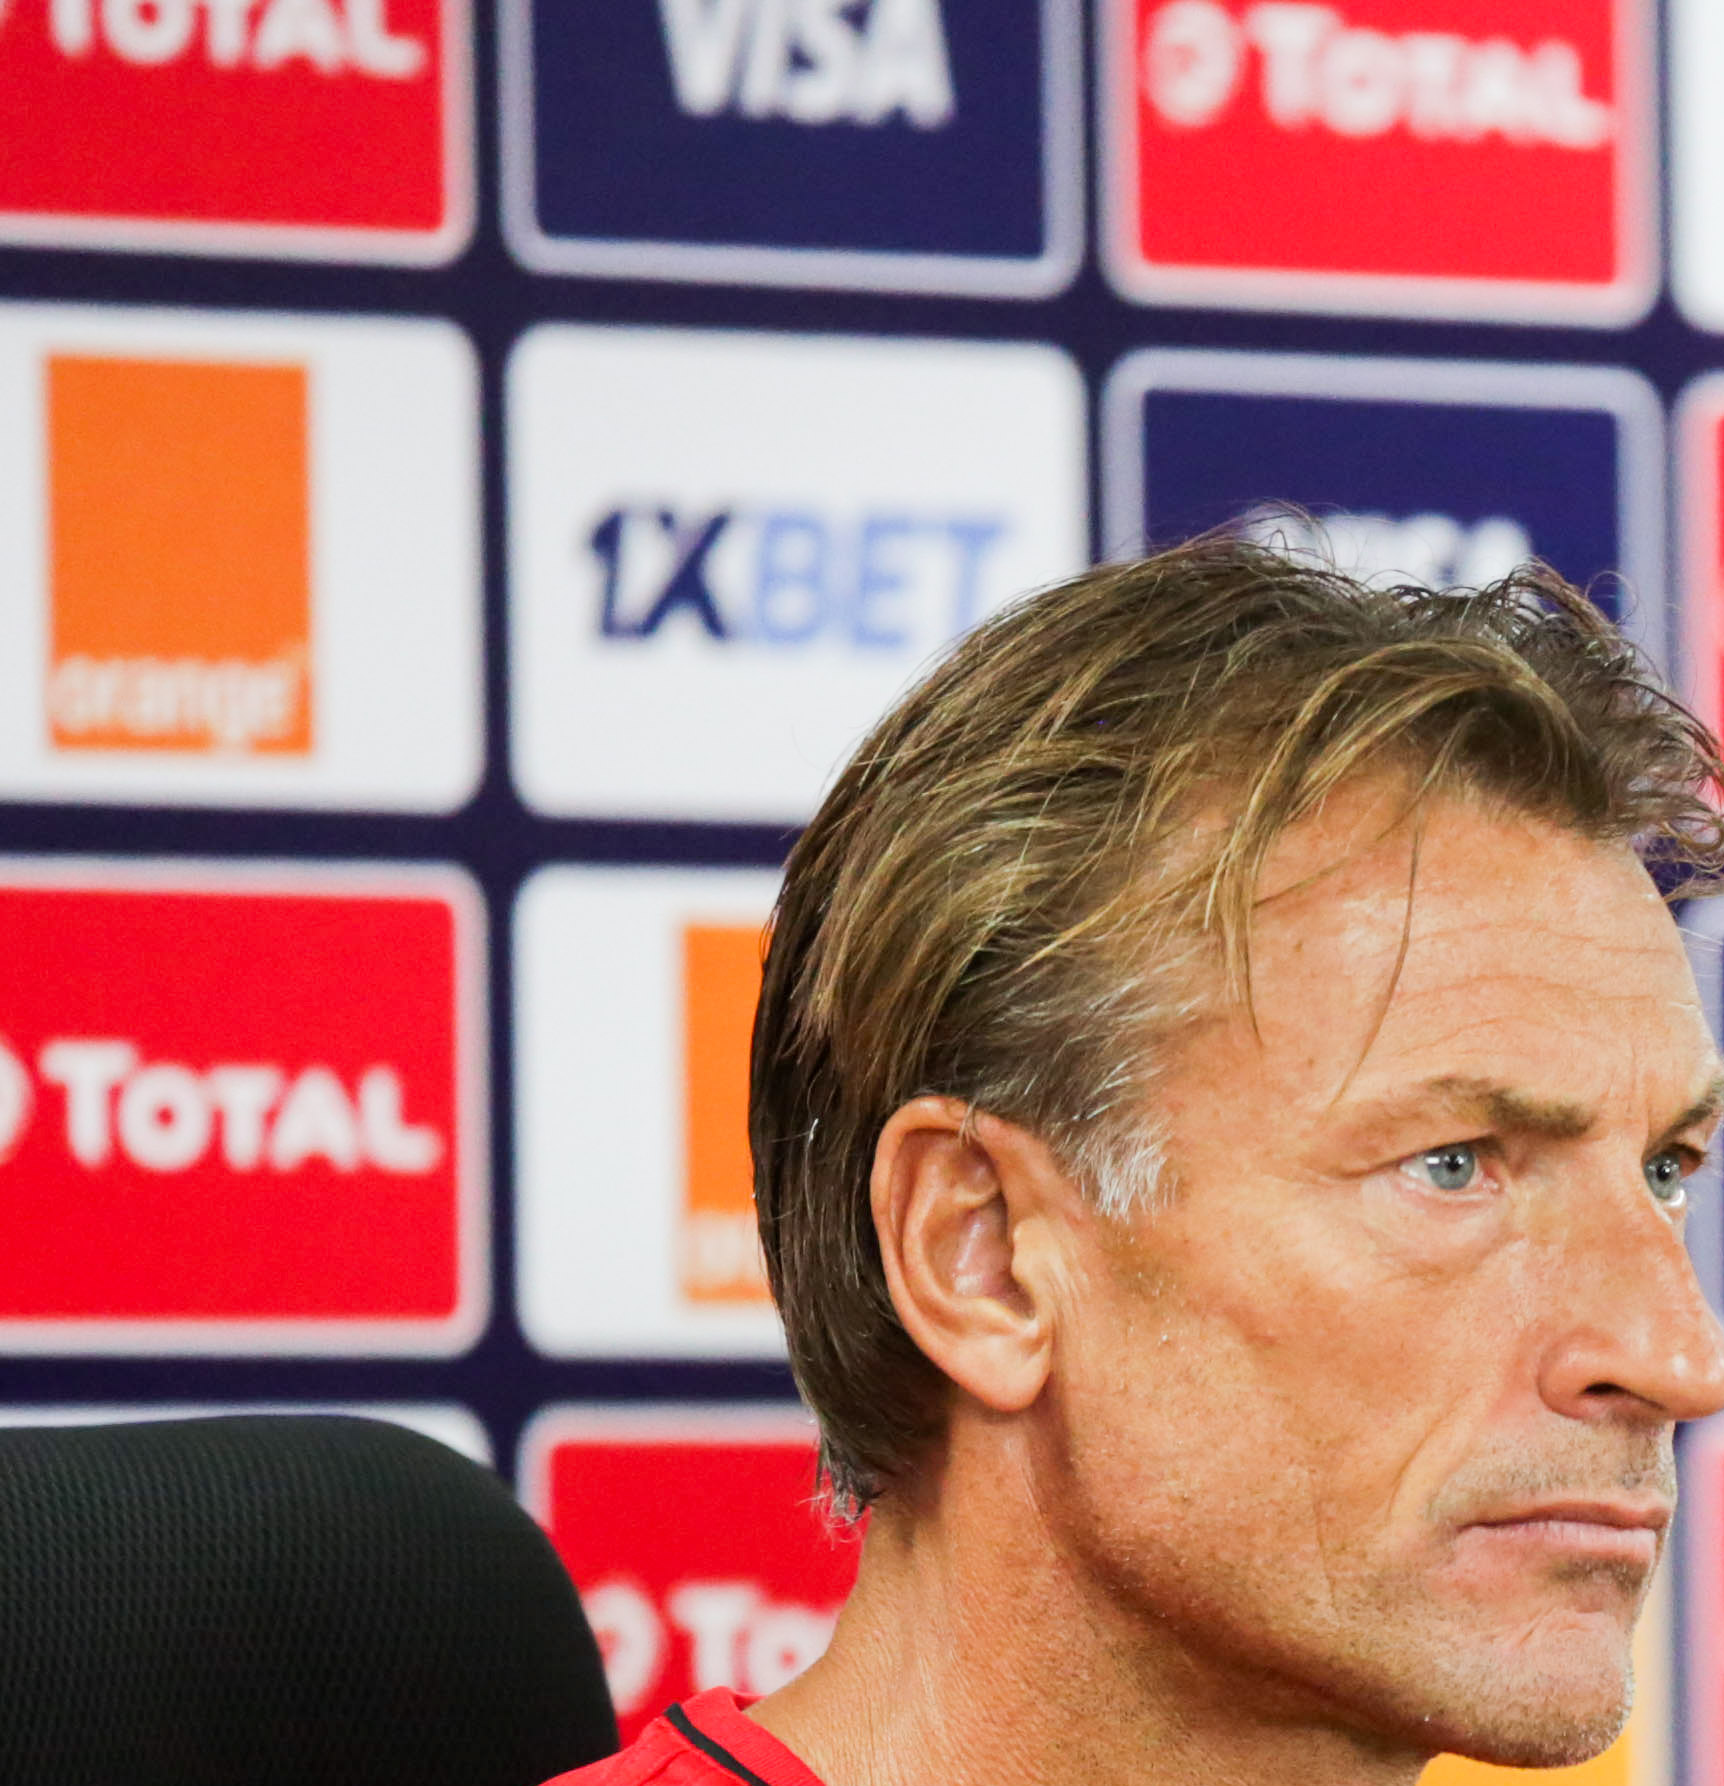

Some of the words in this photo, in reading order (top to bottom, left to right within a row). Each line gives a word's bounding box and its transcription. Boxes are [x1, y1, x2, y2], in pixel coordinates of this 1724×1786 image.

[660, 0, 957, 128] VISA
[584, 508, 1006, 648] 1XBET
[52, 655, 292, 745] orange
[40, 1038, 442, 1173] TOTAL
